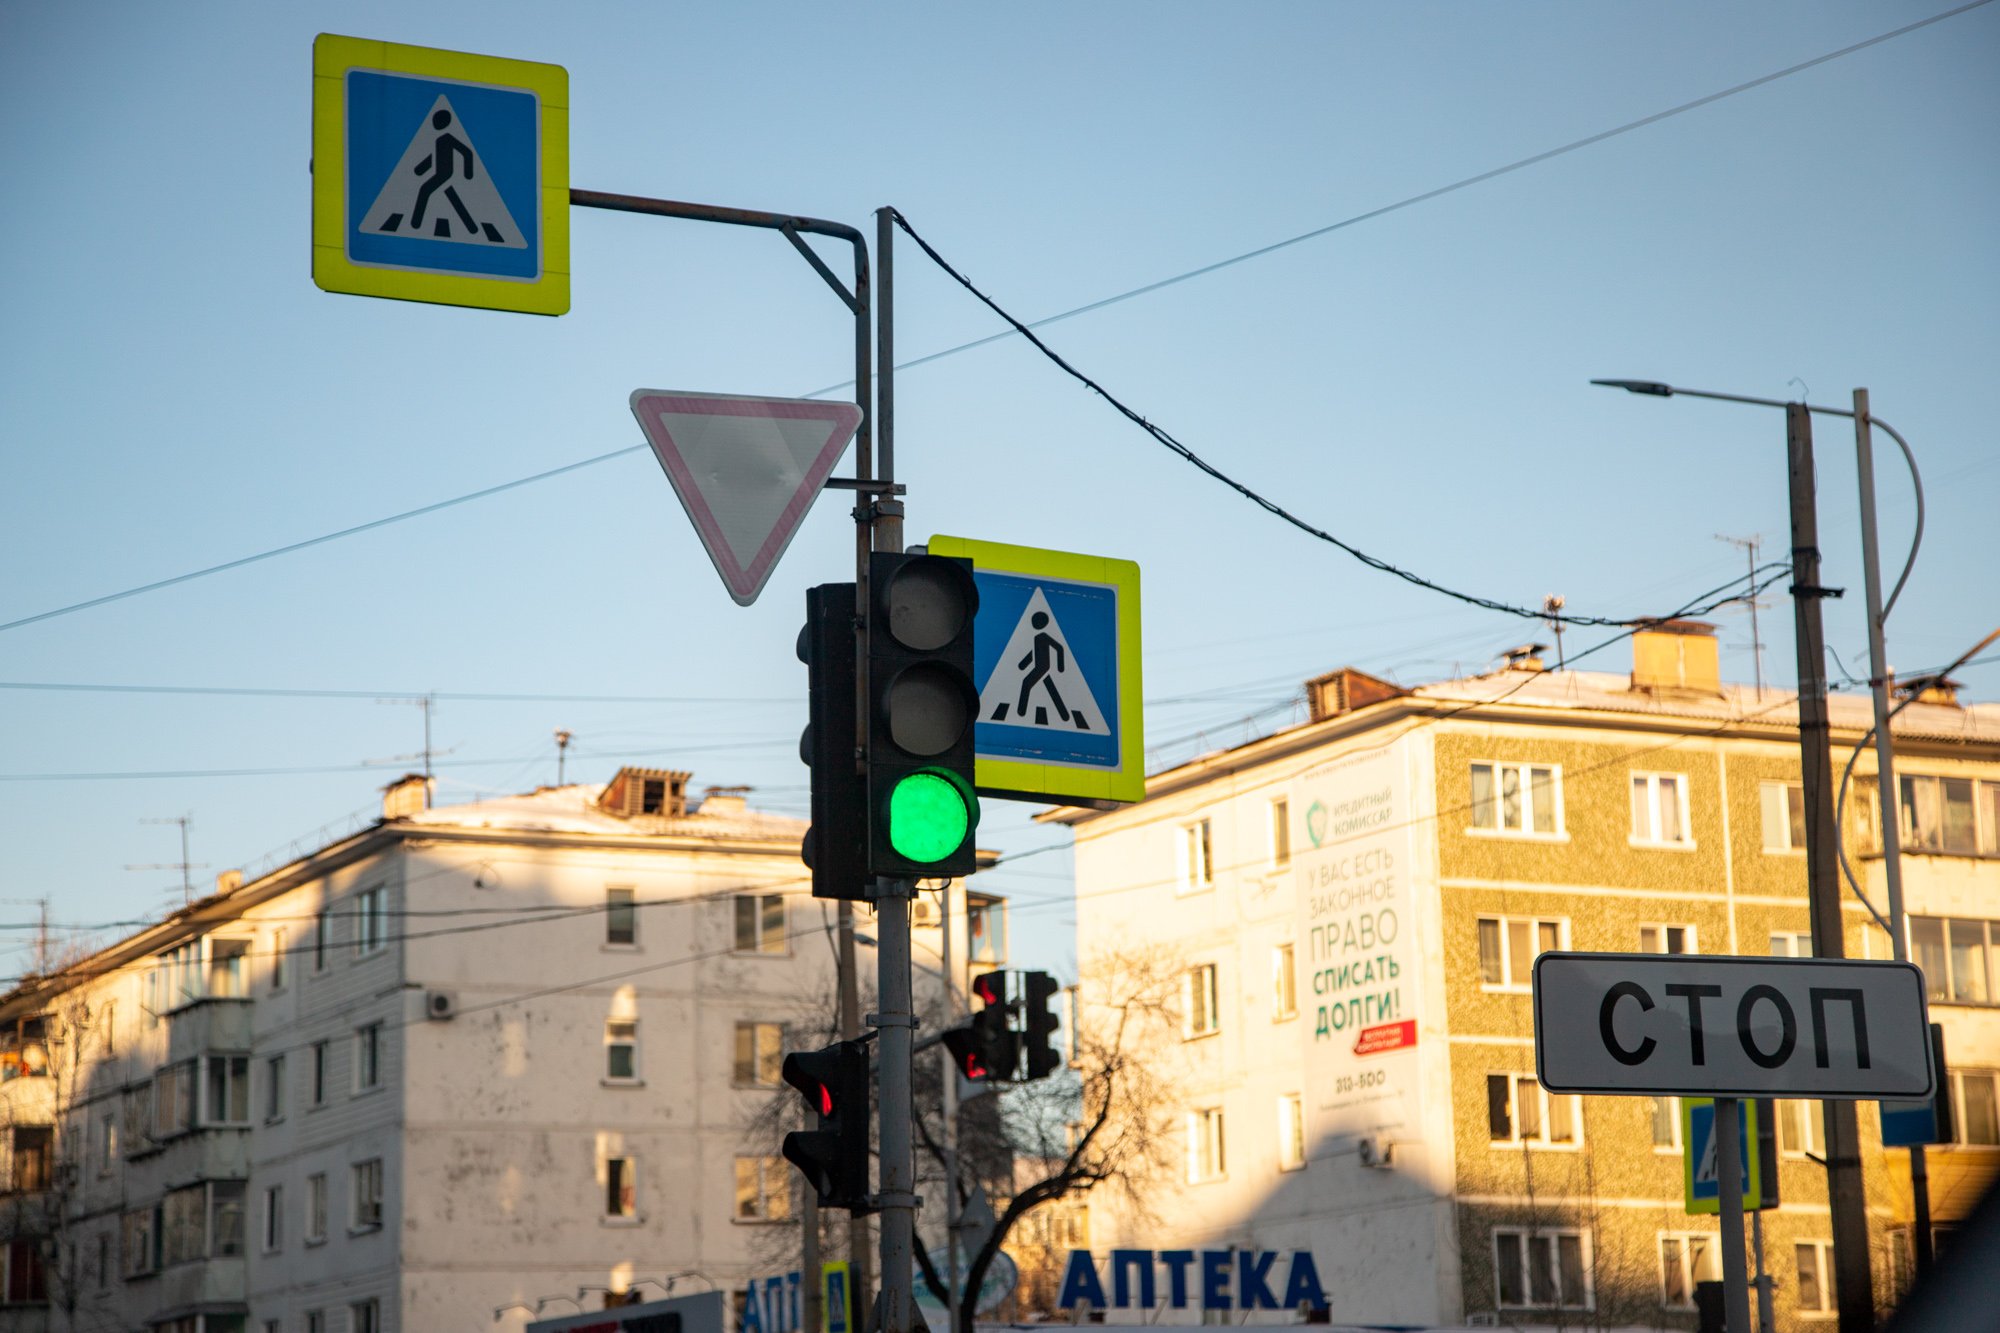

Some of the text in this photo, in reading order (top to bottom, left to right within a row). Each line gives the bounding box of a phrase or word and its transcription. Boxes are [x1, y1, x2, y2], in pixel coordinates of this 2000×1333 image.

[1334, 806, 1392, 837] КОМИССАР
[1320, 857, 1350, 888] ВАС
[1355, 847, 1394, 877] ЕСТЬ
[1310, 875, 1396, 920] ЗАКОННОЕ
[1311, 907, 1398, 964] ПРАВО
[1313, 954, 1400, 995] СПИСАТЬ
[1315, 987, 1400, 1041] ДОЛГИ!
[1600, 980, 1871, 1070] СТОП
[1059, 1249, 1329, 1311] АПТЕКА
